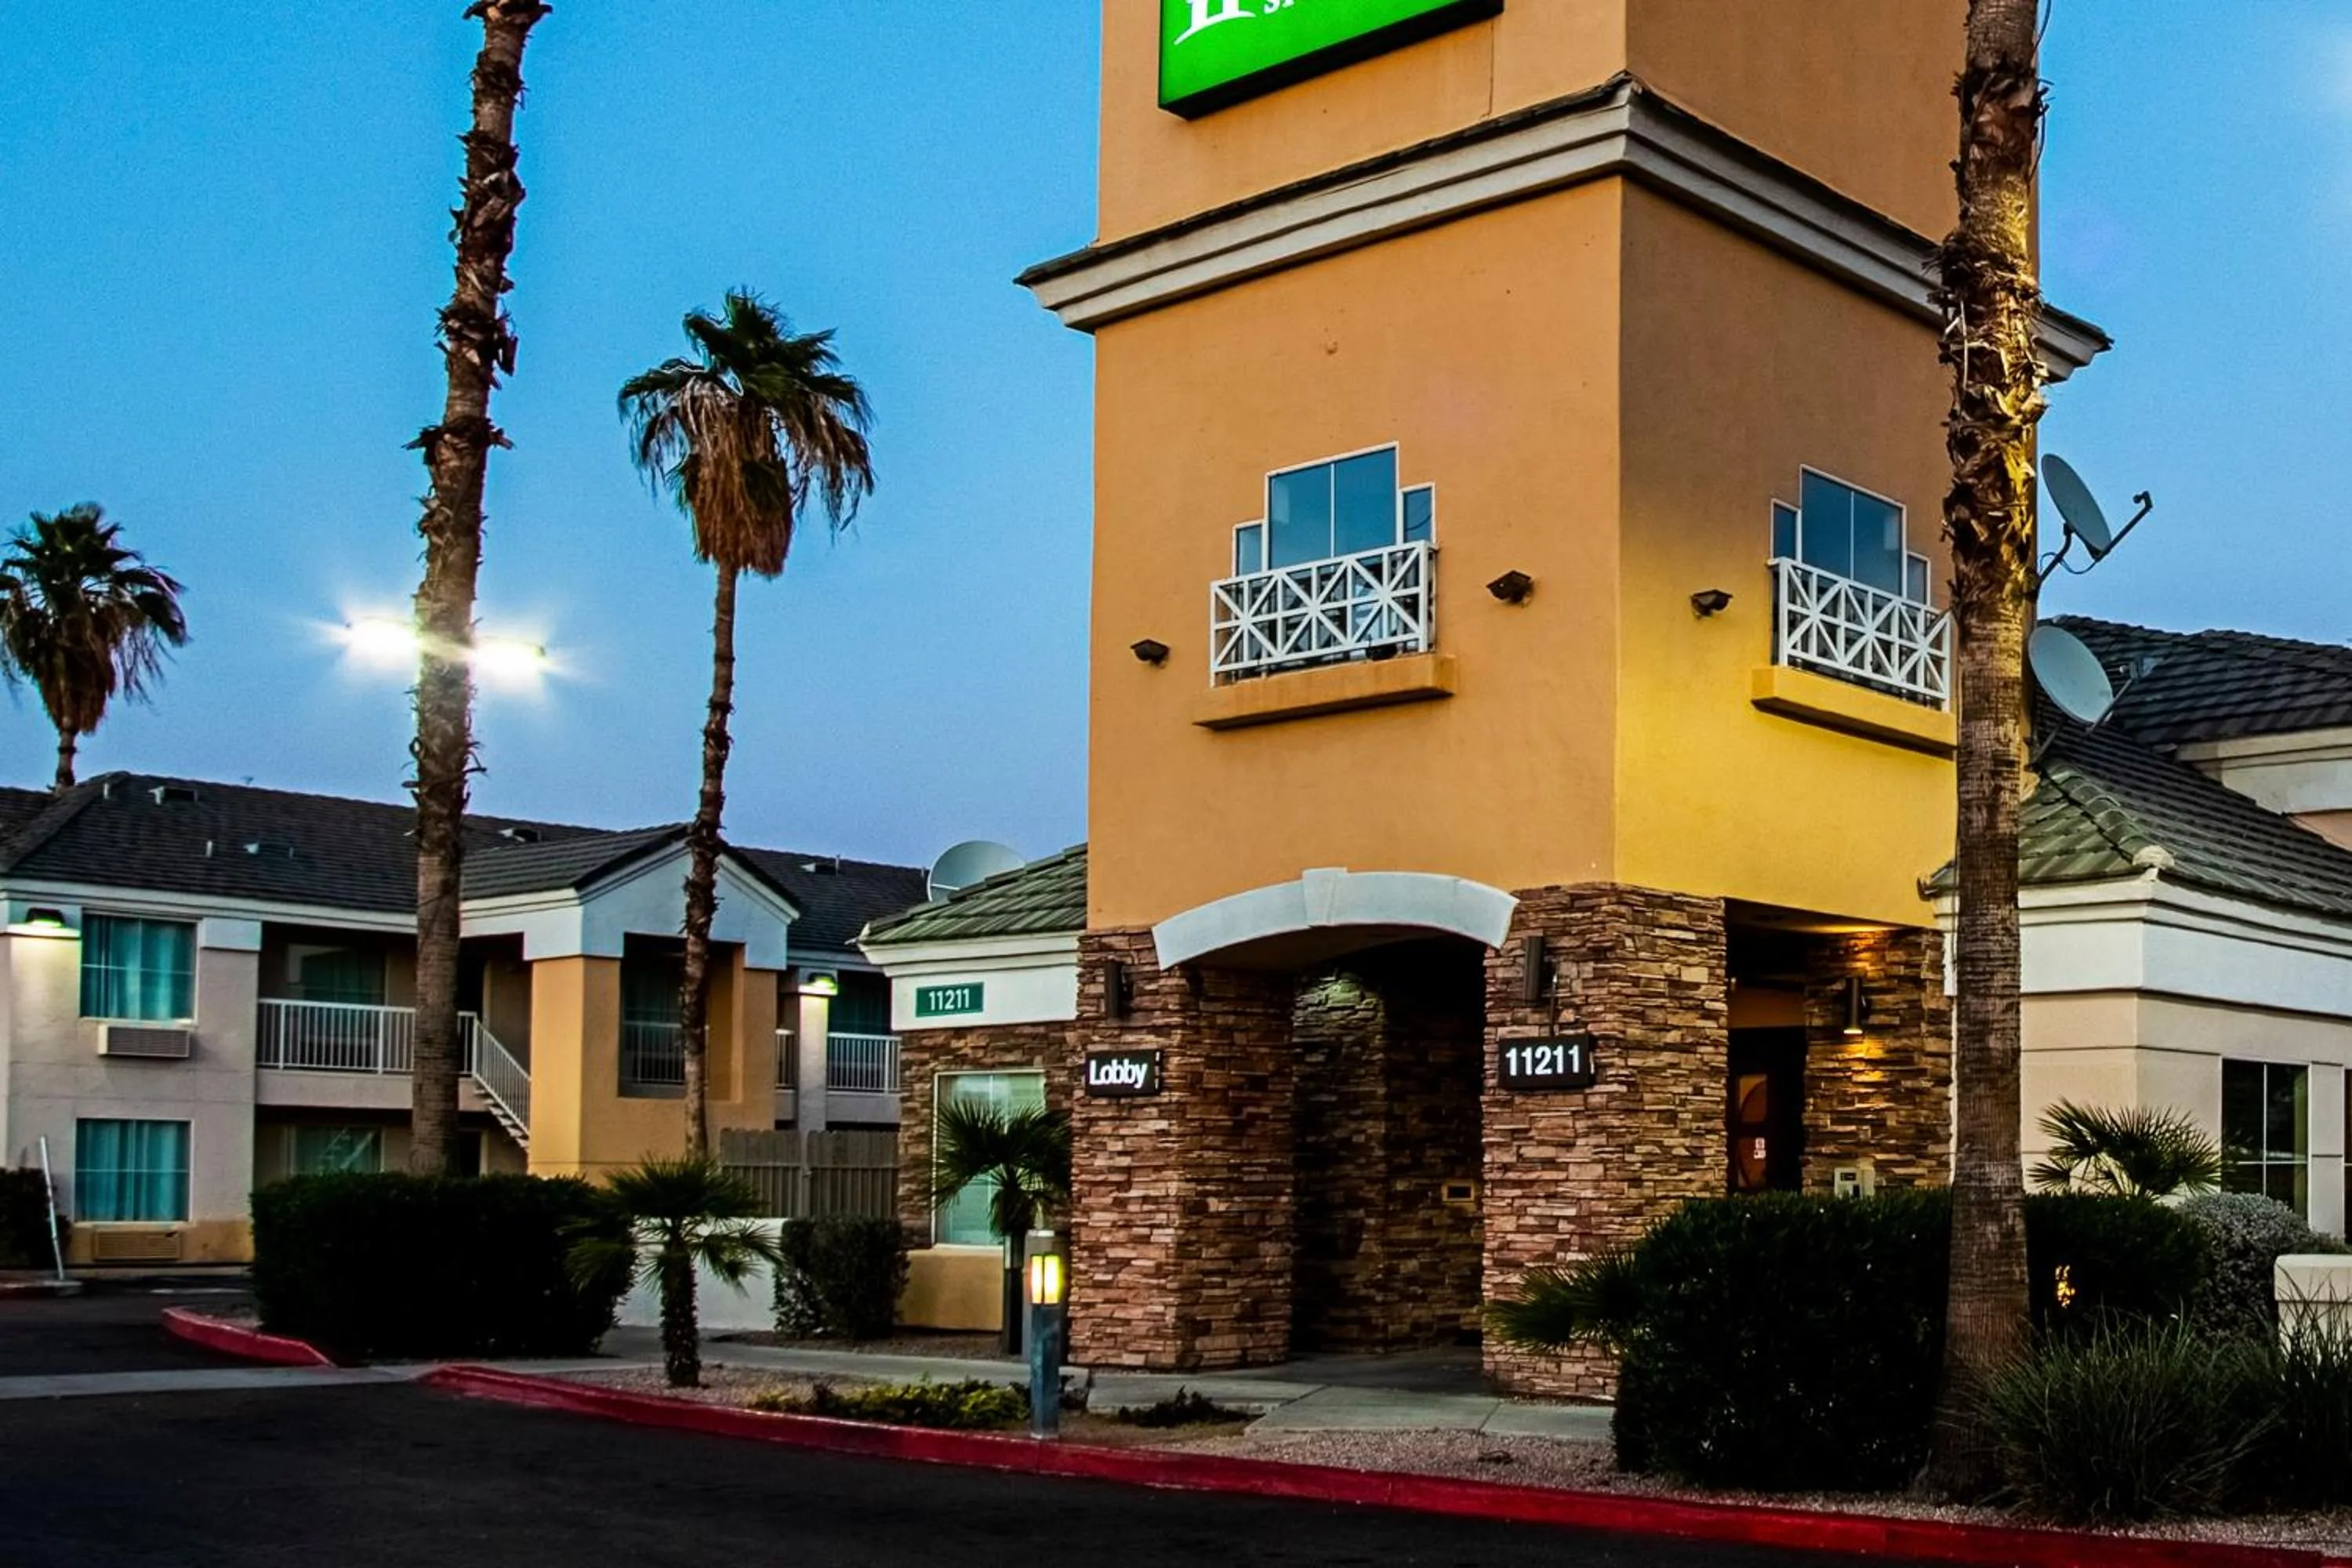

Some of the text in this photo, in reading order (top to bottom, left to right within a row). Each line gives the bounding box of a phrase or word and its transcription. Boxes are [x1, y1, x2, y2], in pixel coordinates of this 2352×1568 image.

[928, 988, 970, 1011] 11211
[1089, 1058, 1149, 1089] Lobby
[1505, 1044, 1580, 1076] 11211
